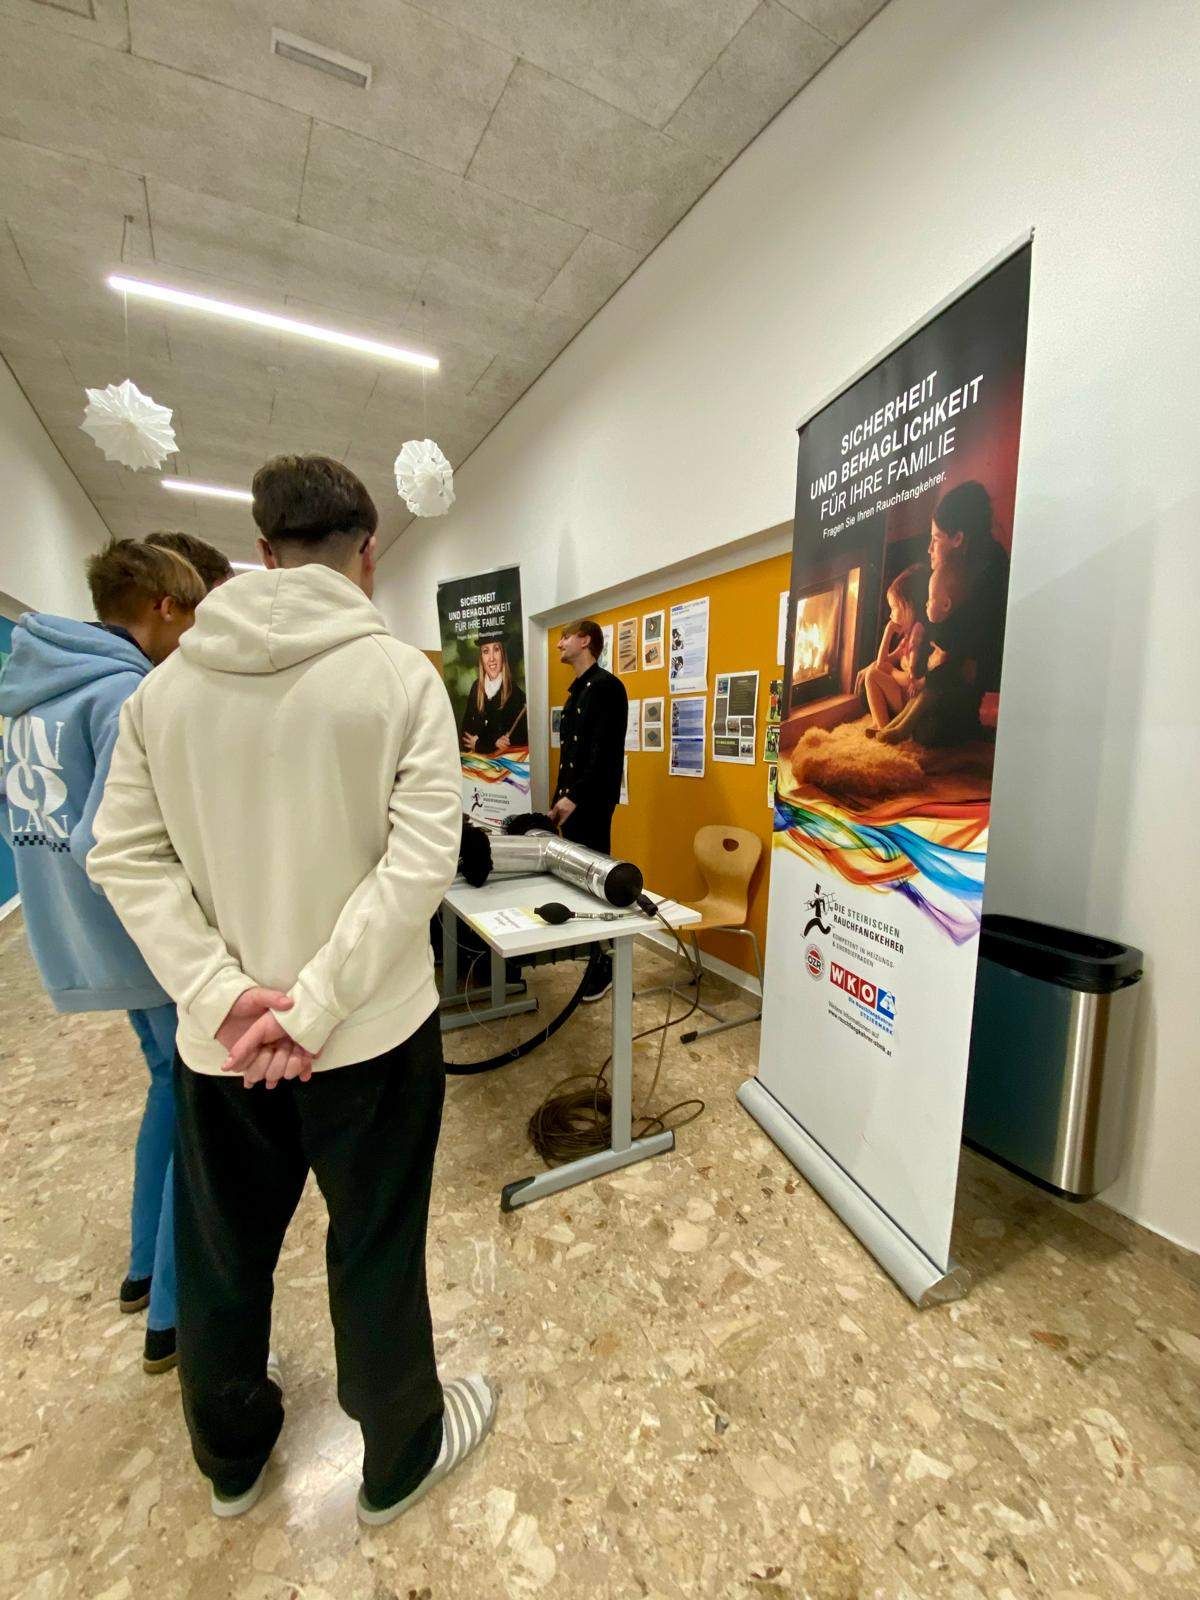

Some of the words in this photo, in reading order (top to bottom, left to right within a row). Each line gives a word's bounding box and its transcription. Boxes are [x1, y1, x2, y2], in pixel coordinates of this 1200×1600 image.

[841, 370, 937, 456] SICHERHEIT
[810, 470, 837, 500] UND
[841, 374, 984, 483] BEHAGLICHKEIT
[820, 493, 846, 520] FÜR
[850, 468, 883, 506] IHRE
[887, 427, 956, 485] FAMILIE
[823, 521, 844, 539] Fragen
[845, 515, 856, 528] Sie
[857, 505, 875, 521] Ihren
[876, 471, 947, 511] Rauchfangkehrer.
[448, 609, 461, 621] UND
[461, 602, 511, 619] BEHAGLICHKEIT
[460, 592, 496, 607] SICHERHEIT
[454, 620, 467, 632] FÜR
[467, 619, 481, 629] IHRE
[481, 615, 505, 628] FAMILIE
[833, 914, 905, 954] RAUCHFANGKEHRER
[834, 902, 846, 915] DIE
[847, 908, 900, 938] STEIRISCHEN
[832, 933, 859, 950] KOMPETENT
[860, 946, 866, 955] IN
[831, 965, 875, 1001] WKO
